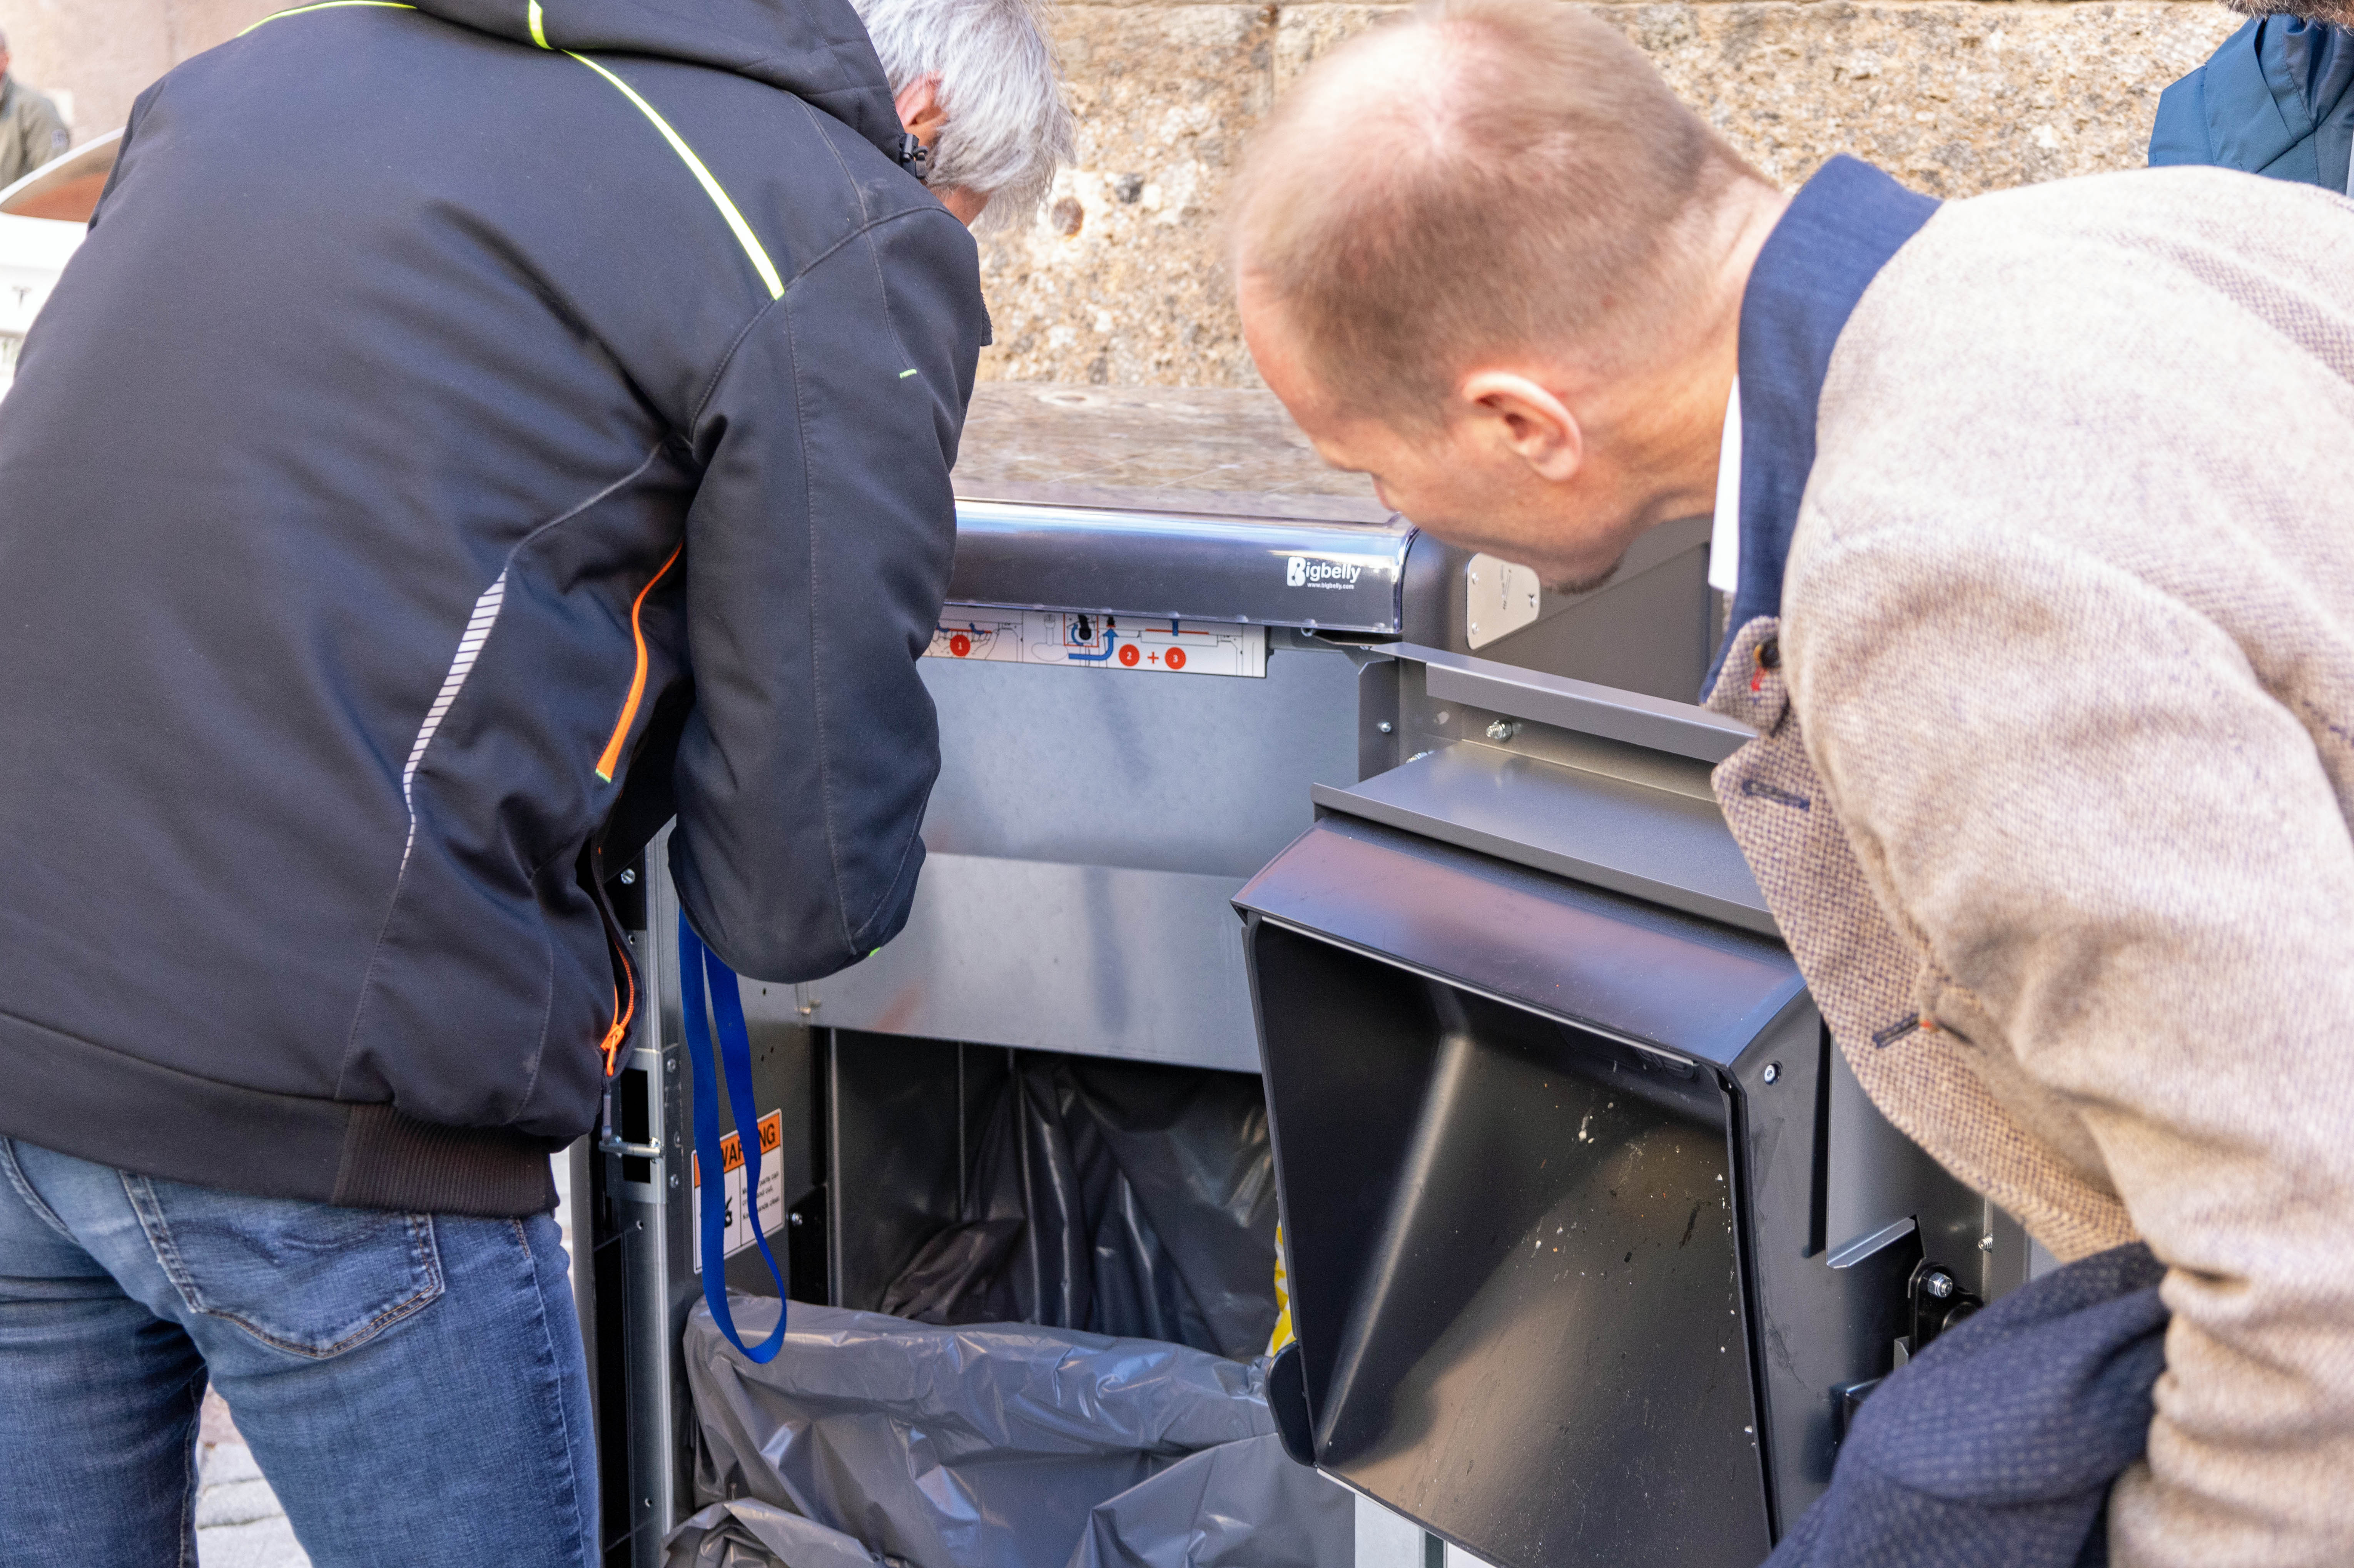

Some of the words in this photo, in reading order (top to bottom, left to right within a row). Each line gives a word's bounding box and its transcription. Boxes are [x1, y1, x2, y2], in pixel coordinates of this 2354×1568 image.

[1286, 556, 1361, 586] Bigbelly
[1307, 582, 1354, 590] www.bigbelly.com
[1126, 651, 1132, 660] 2
[1173, 654, 1178, 663] 3
